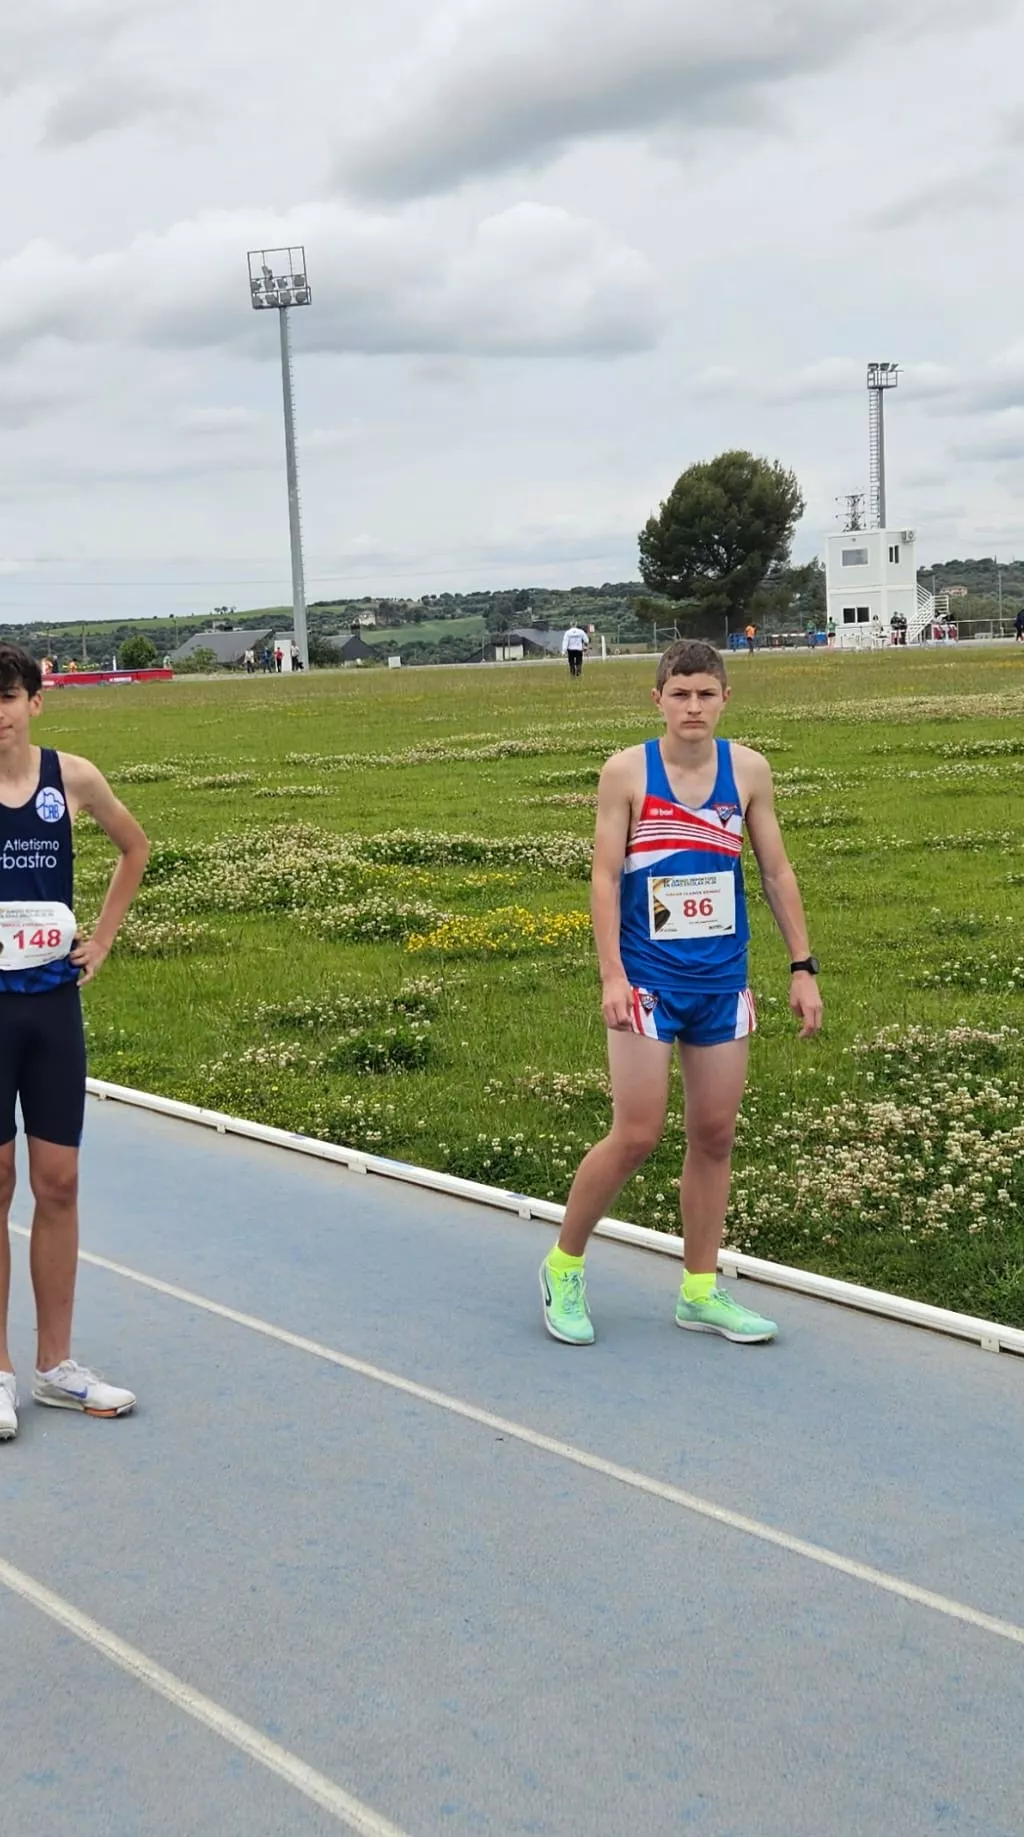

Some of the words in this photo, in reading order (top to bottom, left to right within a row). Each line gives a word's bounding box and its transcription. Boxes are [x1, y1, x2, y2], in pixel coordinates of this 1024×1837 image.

[3, 838, 60, 852] Atletismo
[683, 897, 713, 917] 86
[13, 928, 62, 950] 148
